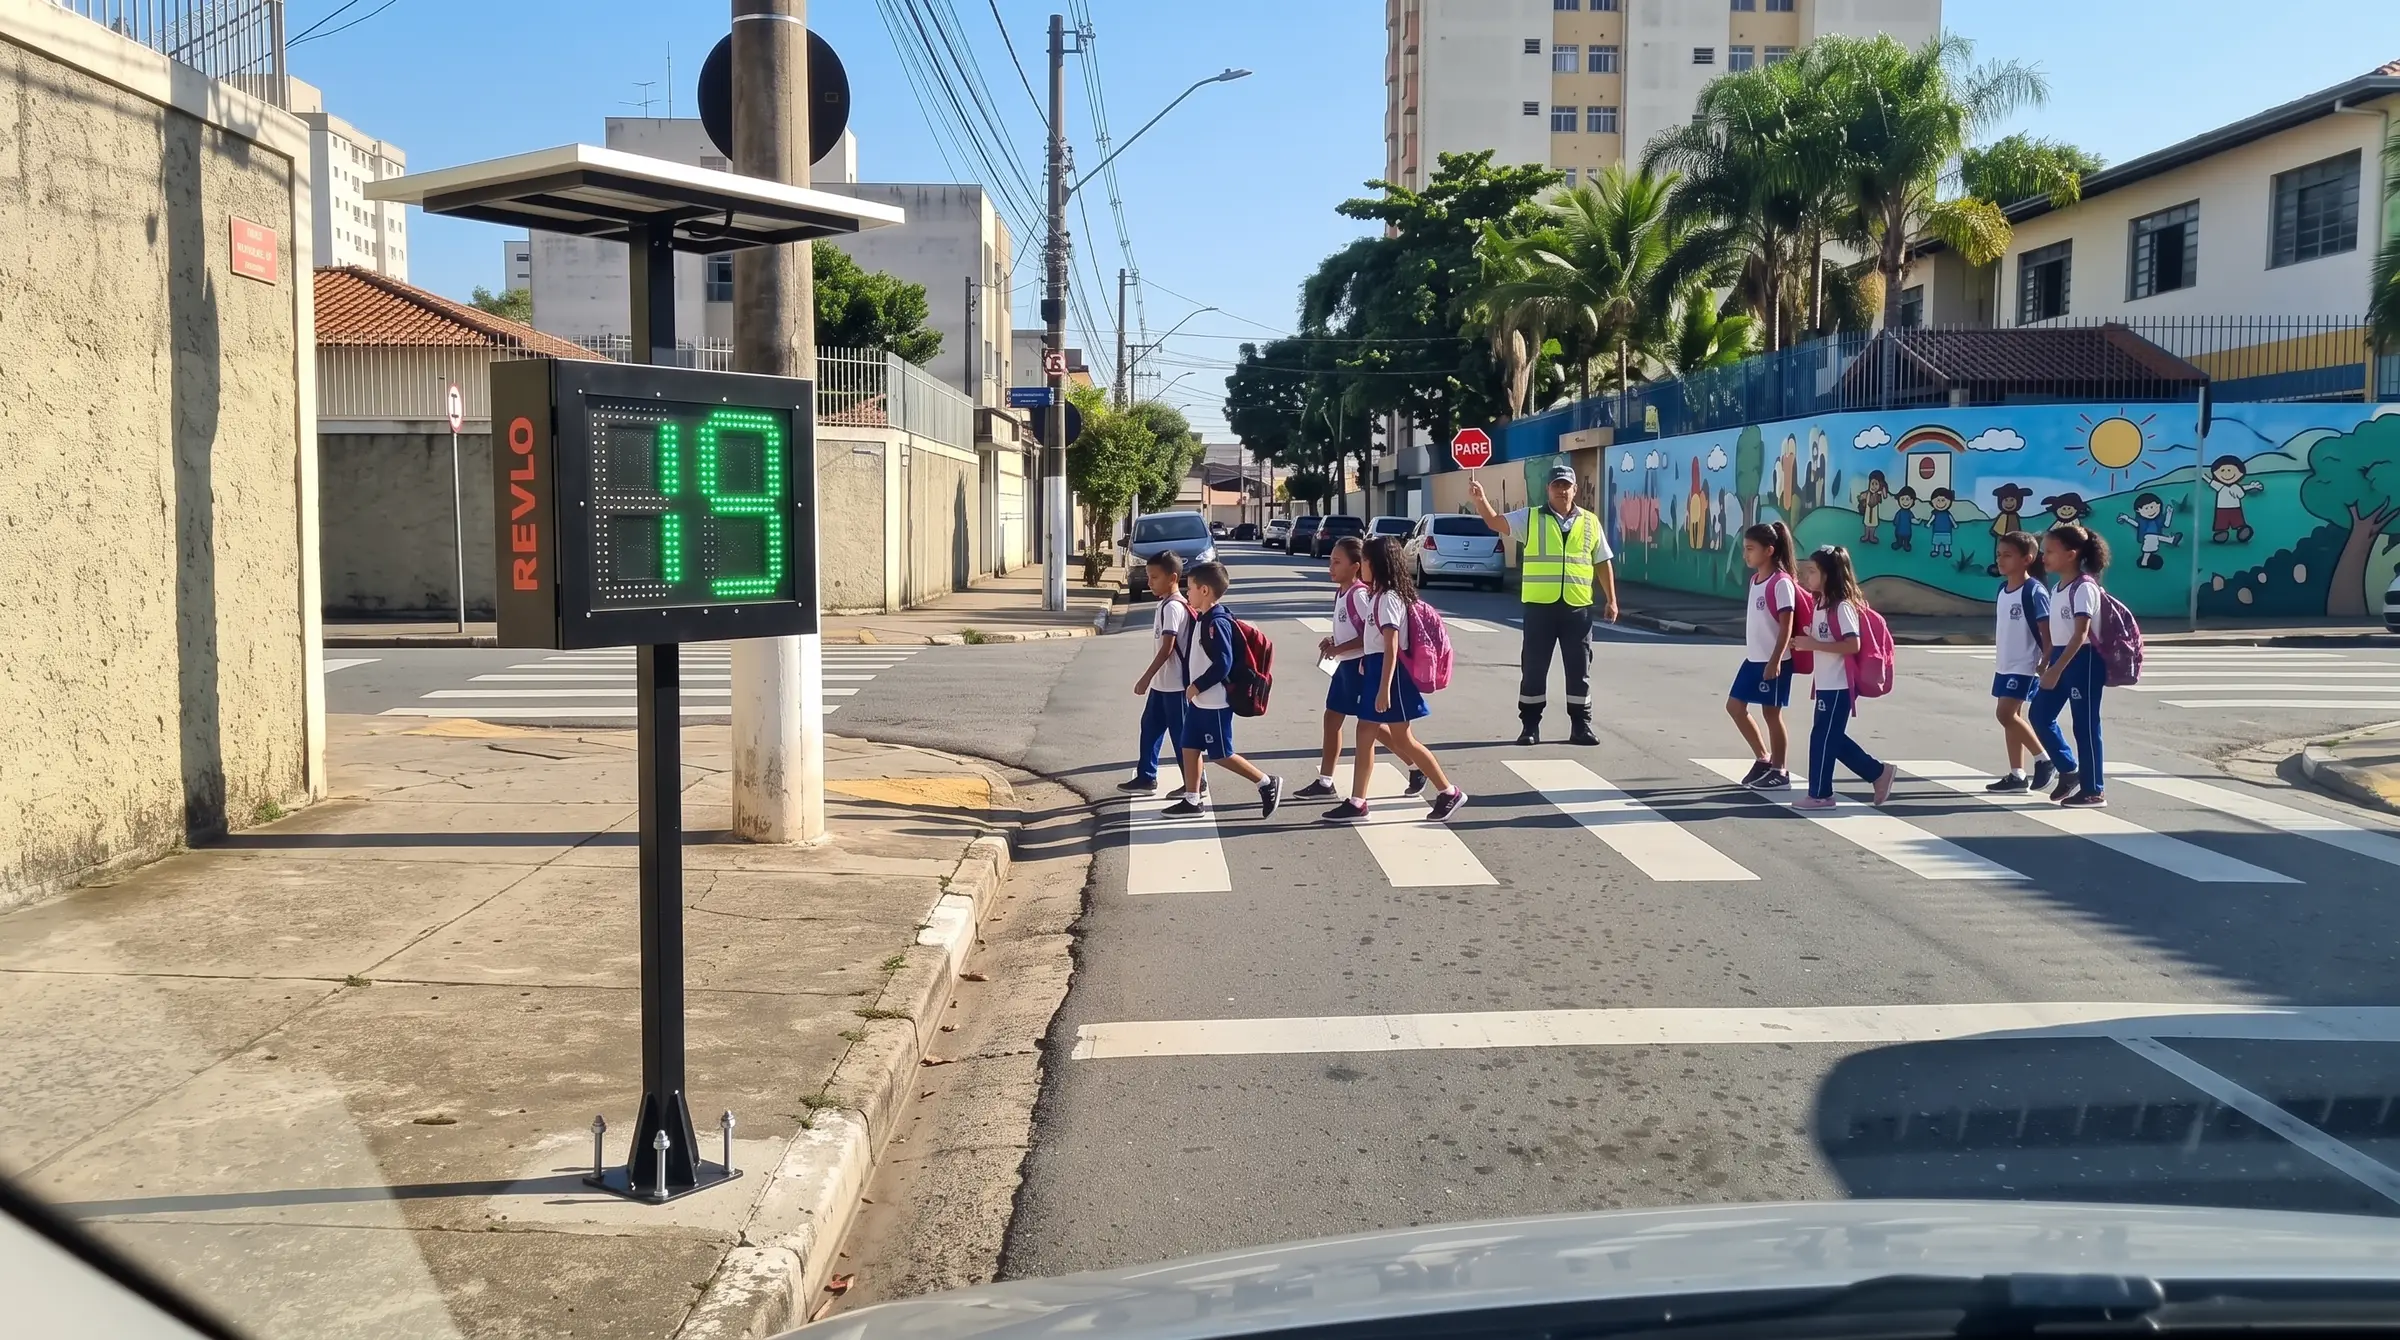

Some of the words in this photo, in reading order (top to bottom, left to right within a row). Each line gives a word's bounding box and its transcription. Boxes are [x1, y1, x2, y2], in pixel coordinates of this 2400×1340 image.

[508, 416, 538, 591] REVLO
[660, 411, 783, 597] 19
[1455, 442, 1489, 456] PARE
